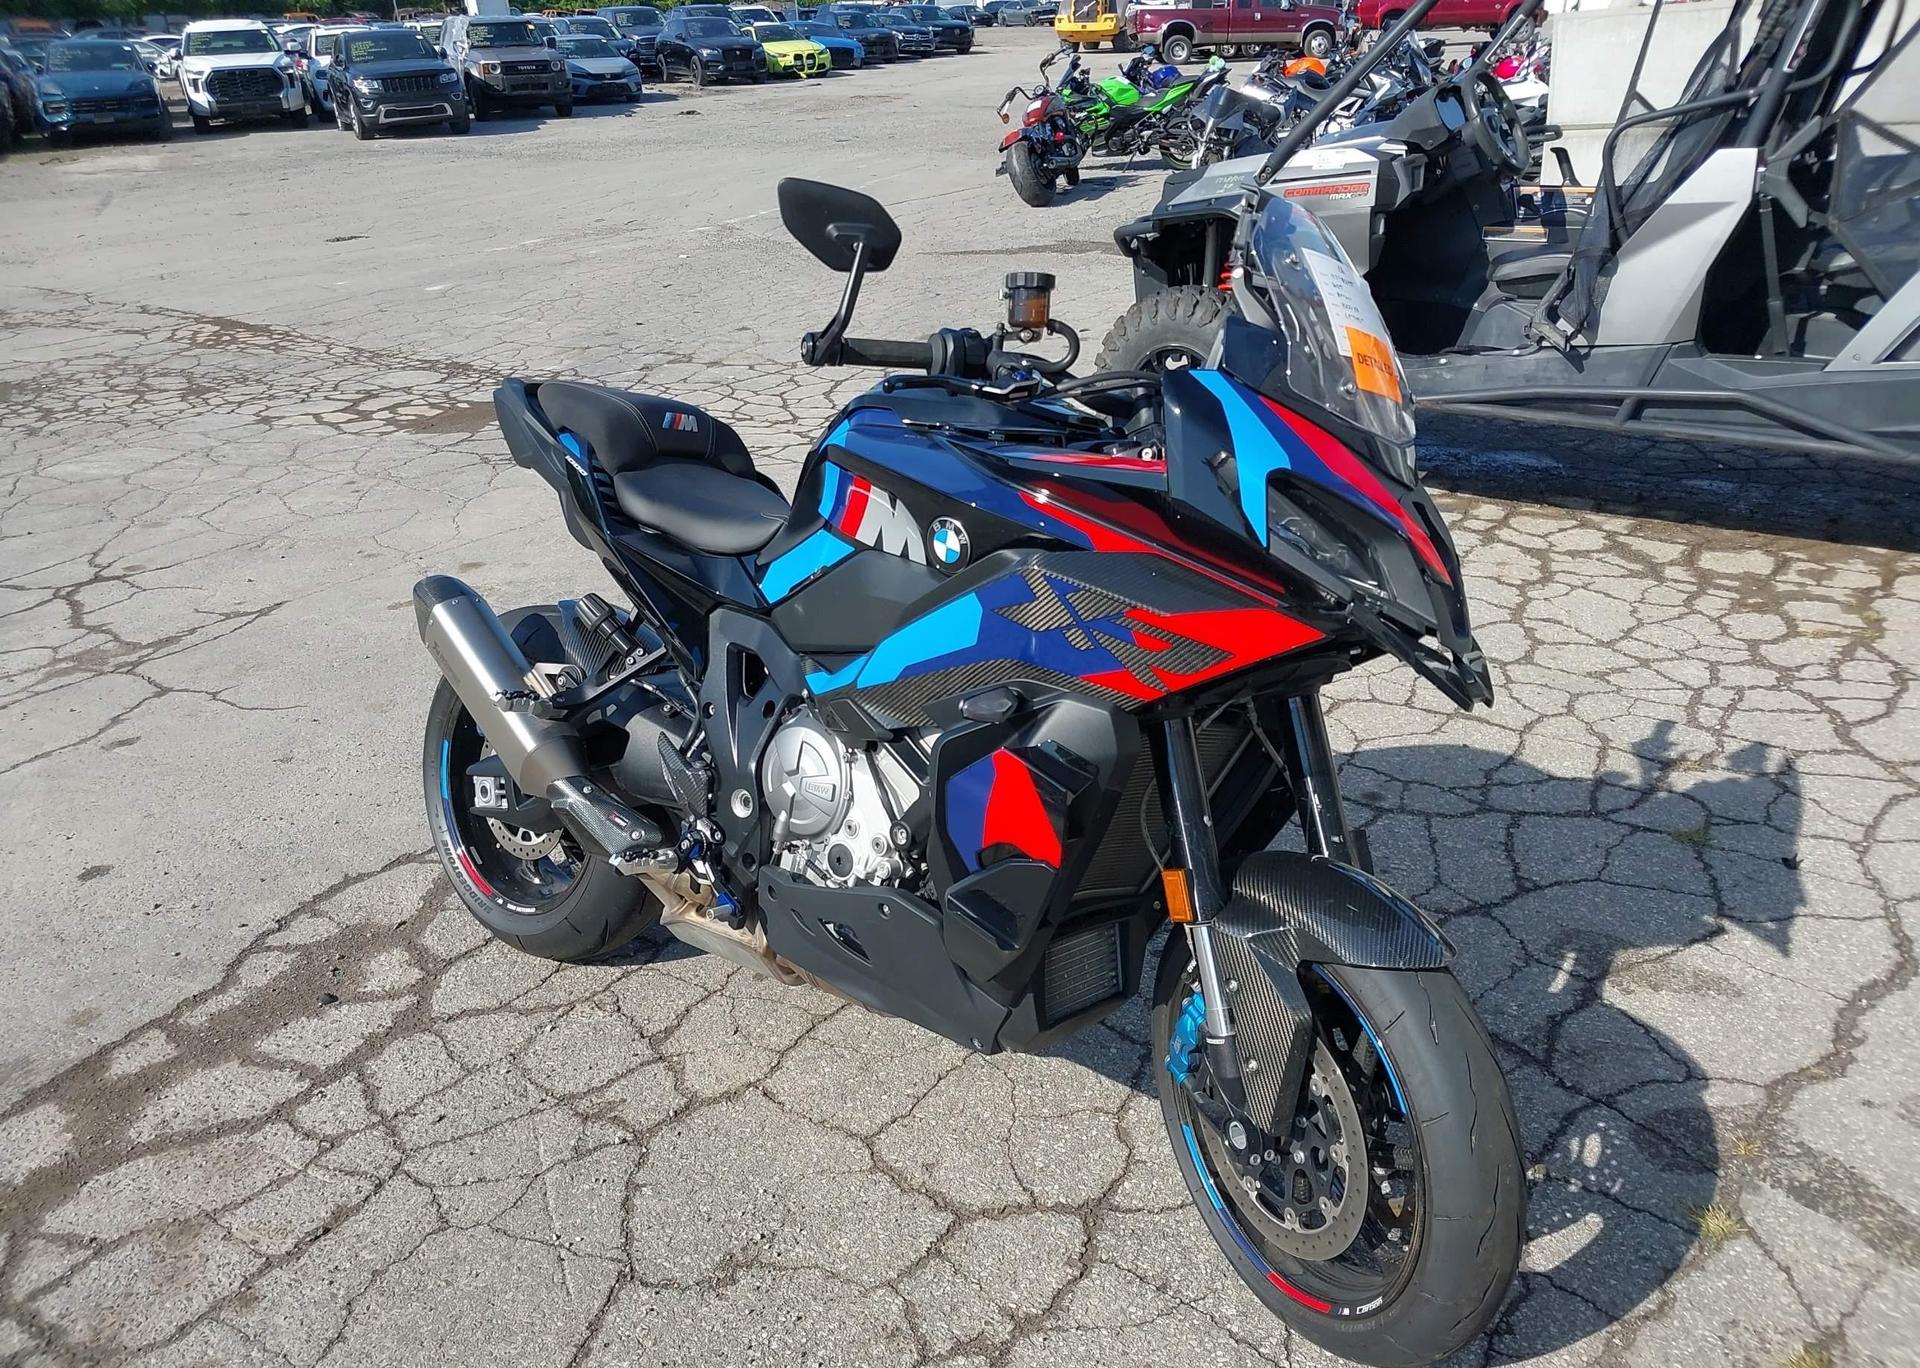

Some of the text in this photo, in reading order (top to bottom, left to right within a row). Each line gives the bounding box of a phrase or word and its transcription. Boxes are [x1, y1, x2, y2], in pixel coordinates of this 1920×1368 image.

[1284, 184, 1370, 198] COMMANDER
[565, 455, 589, 477] 1000
[932, 521, 968, 546] BMW
[441, 838, 494, 913] BRIDGESTONE
